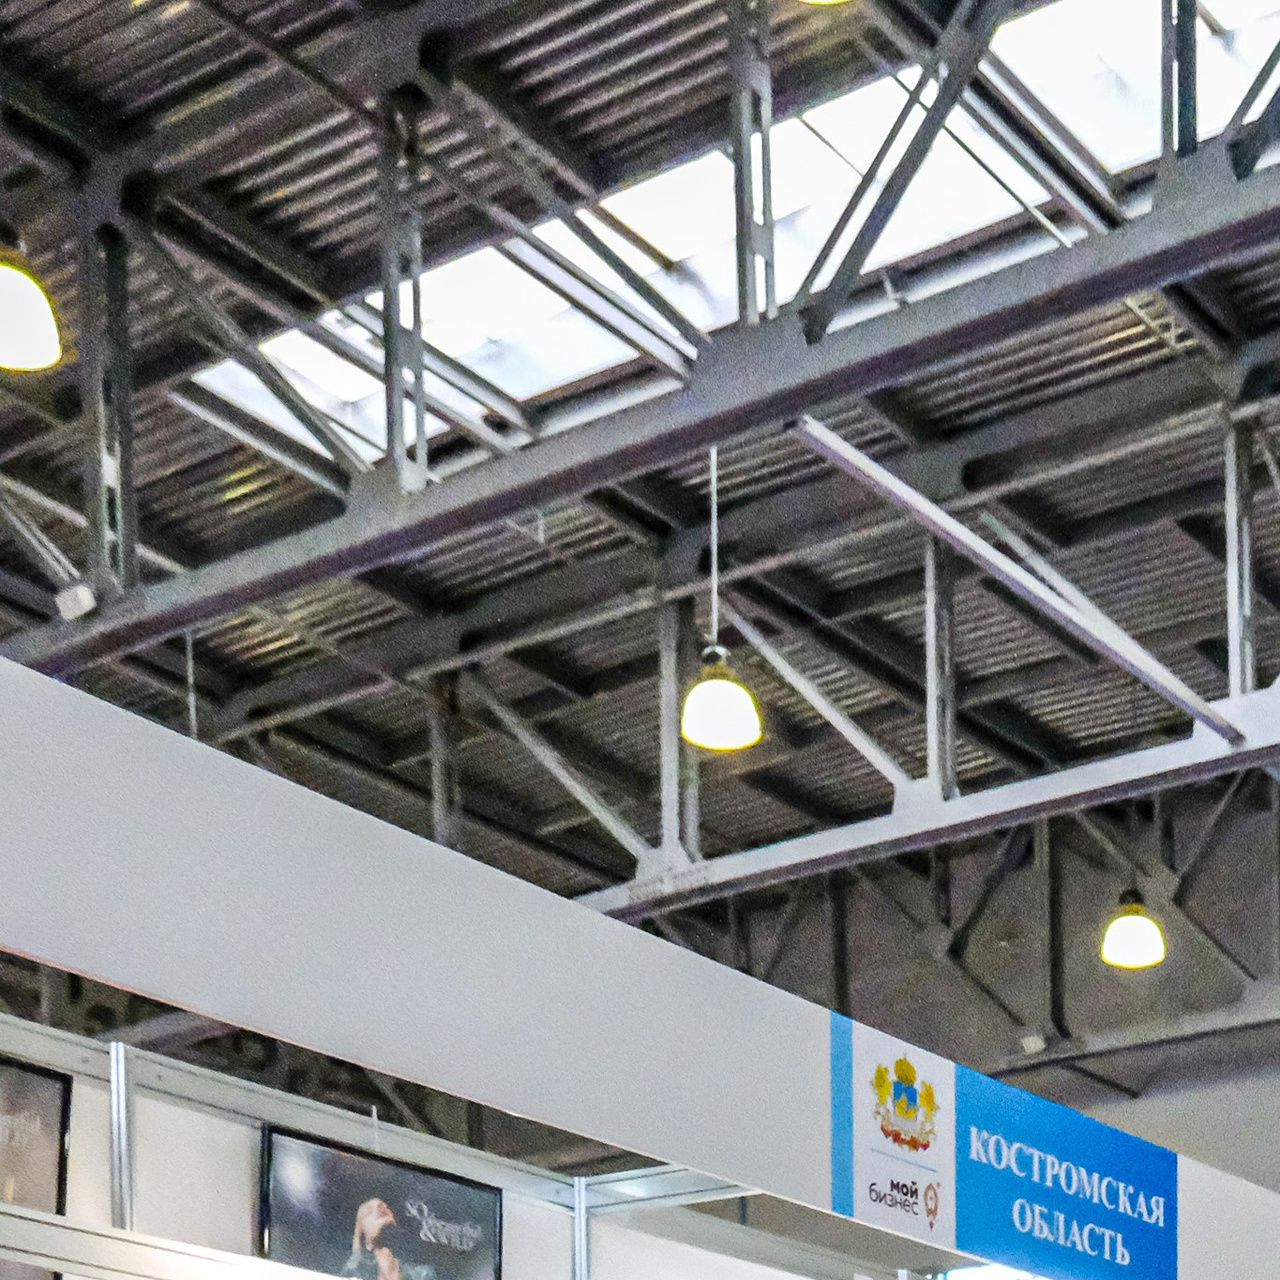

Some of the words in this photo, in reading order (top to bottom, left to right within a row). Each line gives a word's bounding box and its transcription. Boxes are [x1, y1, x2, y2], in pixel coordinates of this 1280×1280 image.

[868, 1182, 919, 1216] бизнес
[968, 1125, 1165, 1228] КОСТРОМСКАЯ
[1012, 1198, 1131, 1266] ОБЛАСТЬ
